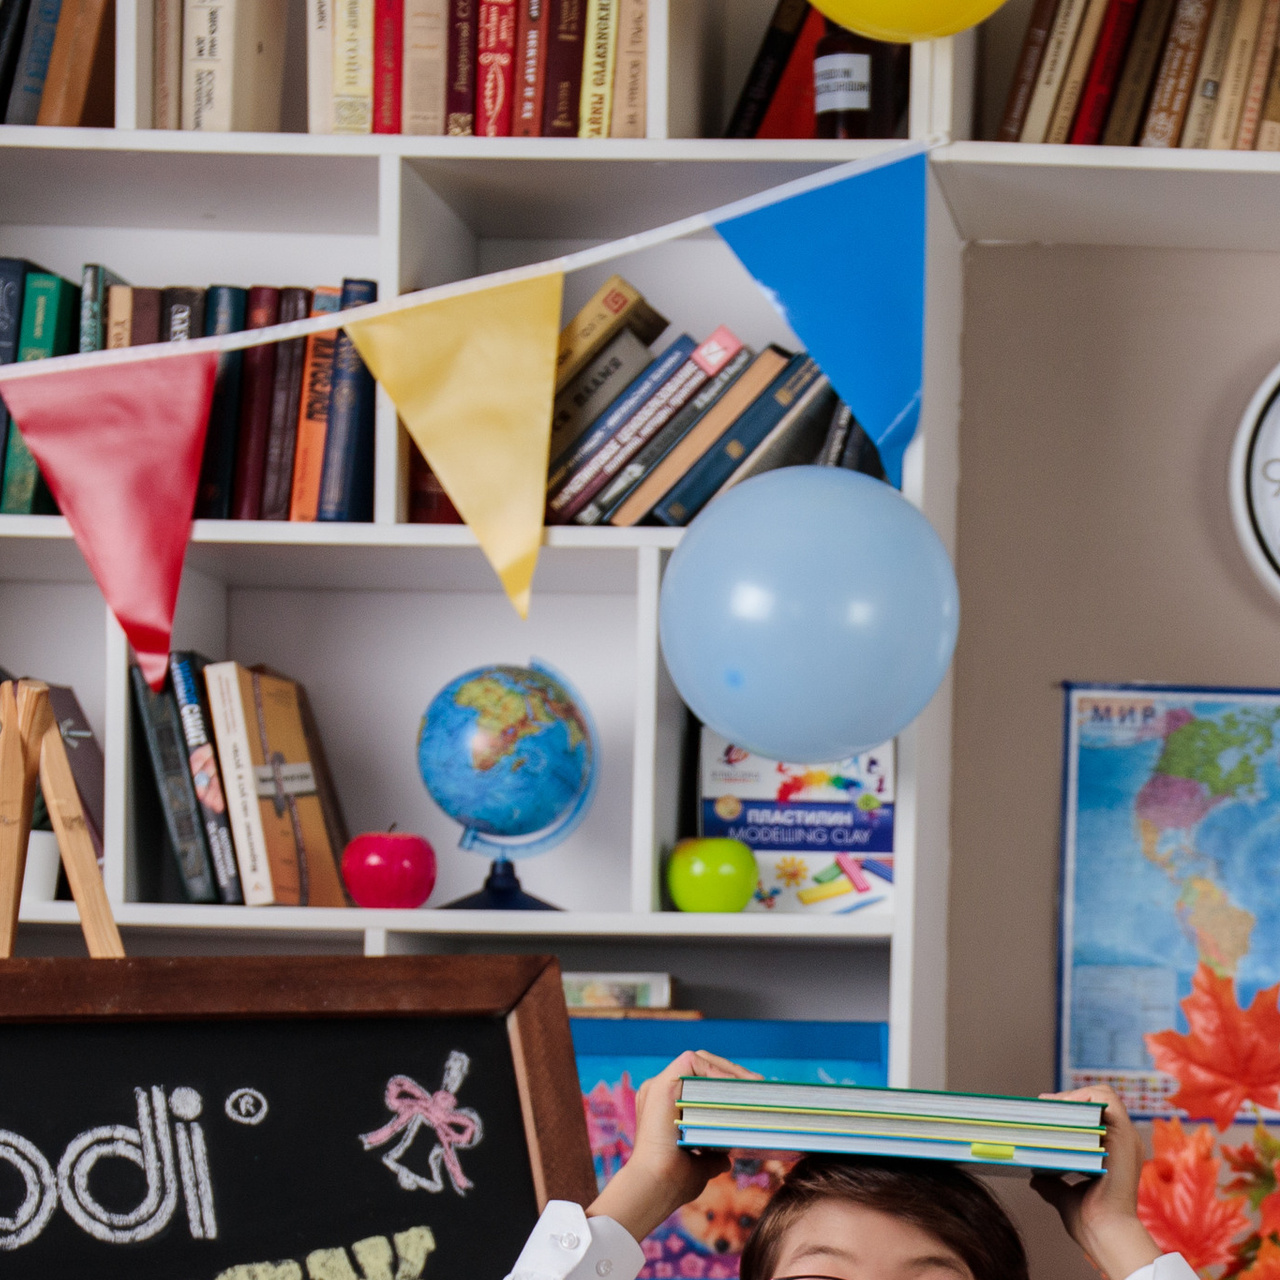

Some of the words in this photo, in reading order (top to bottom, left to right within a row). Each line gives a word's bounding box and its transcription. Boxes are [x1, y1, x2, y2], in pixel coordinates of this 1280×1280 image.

[587, 94, 604, 138] АЙНЫ
[1091, 705, 1158, 724] МИР
[747, 810, 853, 825] ПЛАСТИЛИН
[728, 827, 827, 844] MODELLING
[832, 828, 872, 844] CLAY
